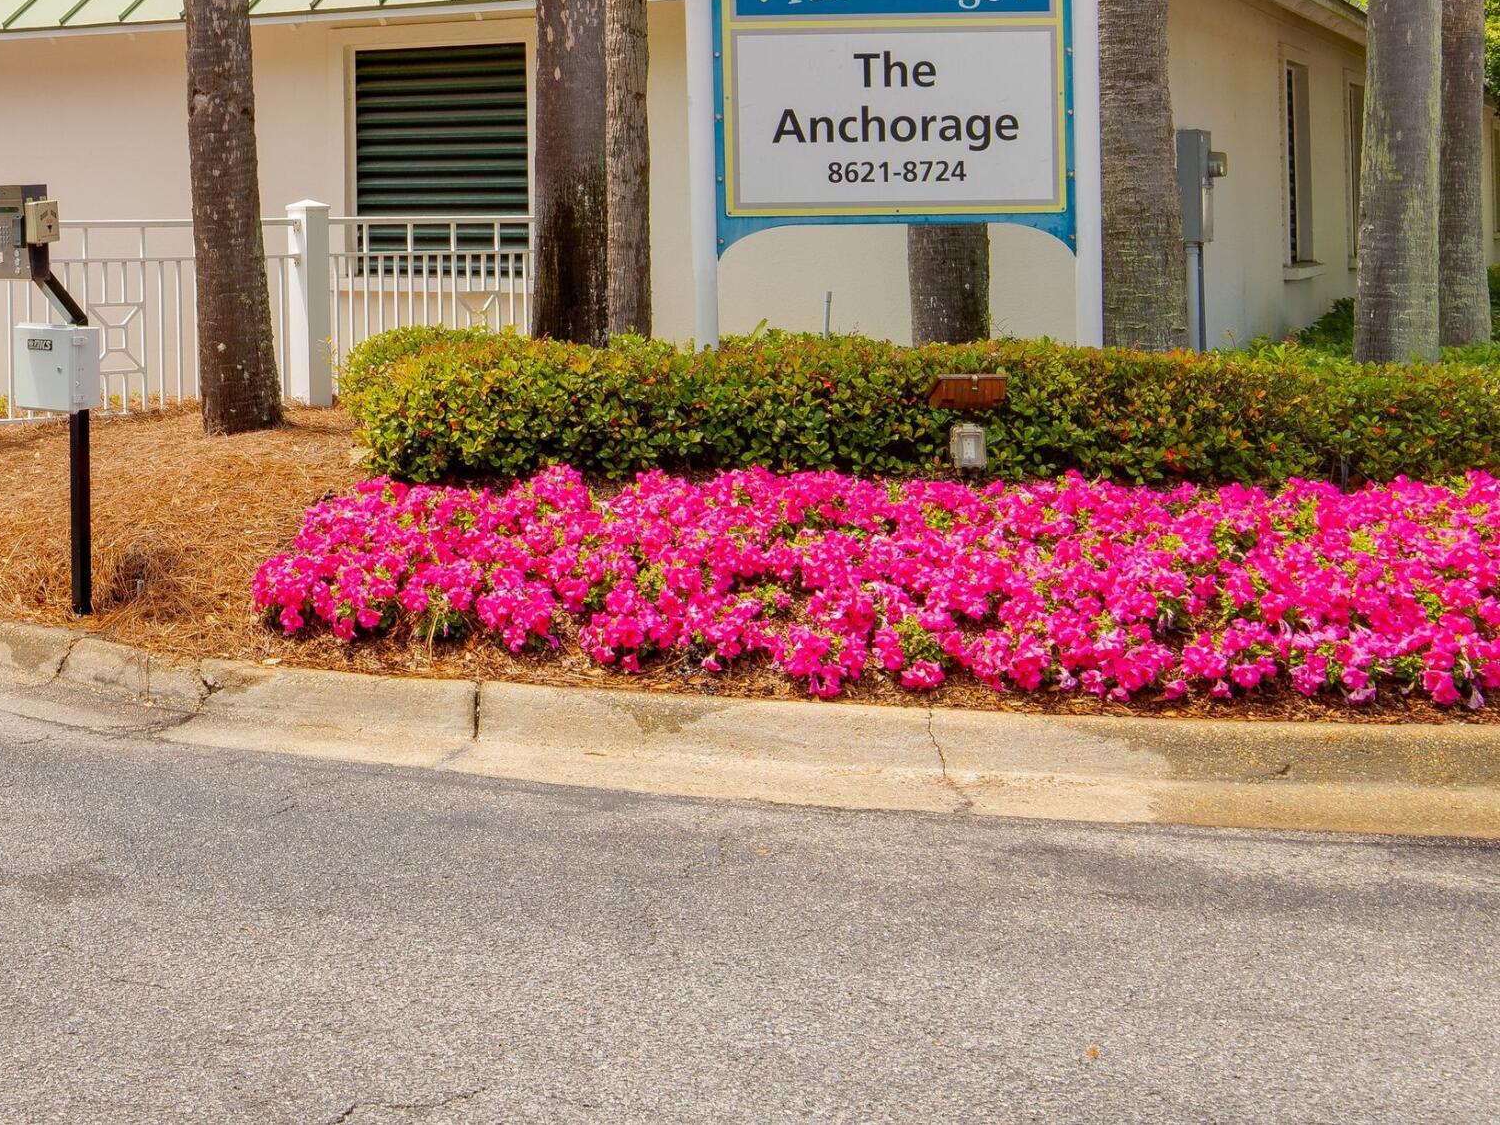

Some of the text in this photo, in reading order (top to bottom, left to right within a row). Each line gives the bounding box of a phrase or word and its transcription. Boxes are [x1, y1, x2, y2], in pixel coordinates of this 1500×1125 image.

[853, 50, 937, 88] The
[772, 105, 1019, 151] Anchorage
[828, 160, 967, 184] 8621-8724
